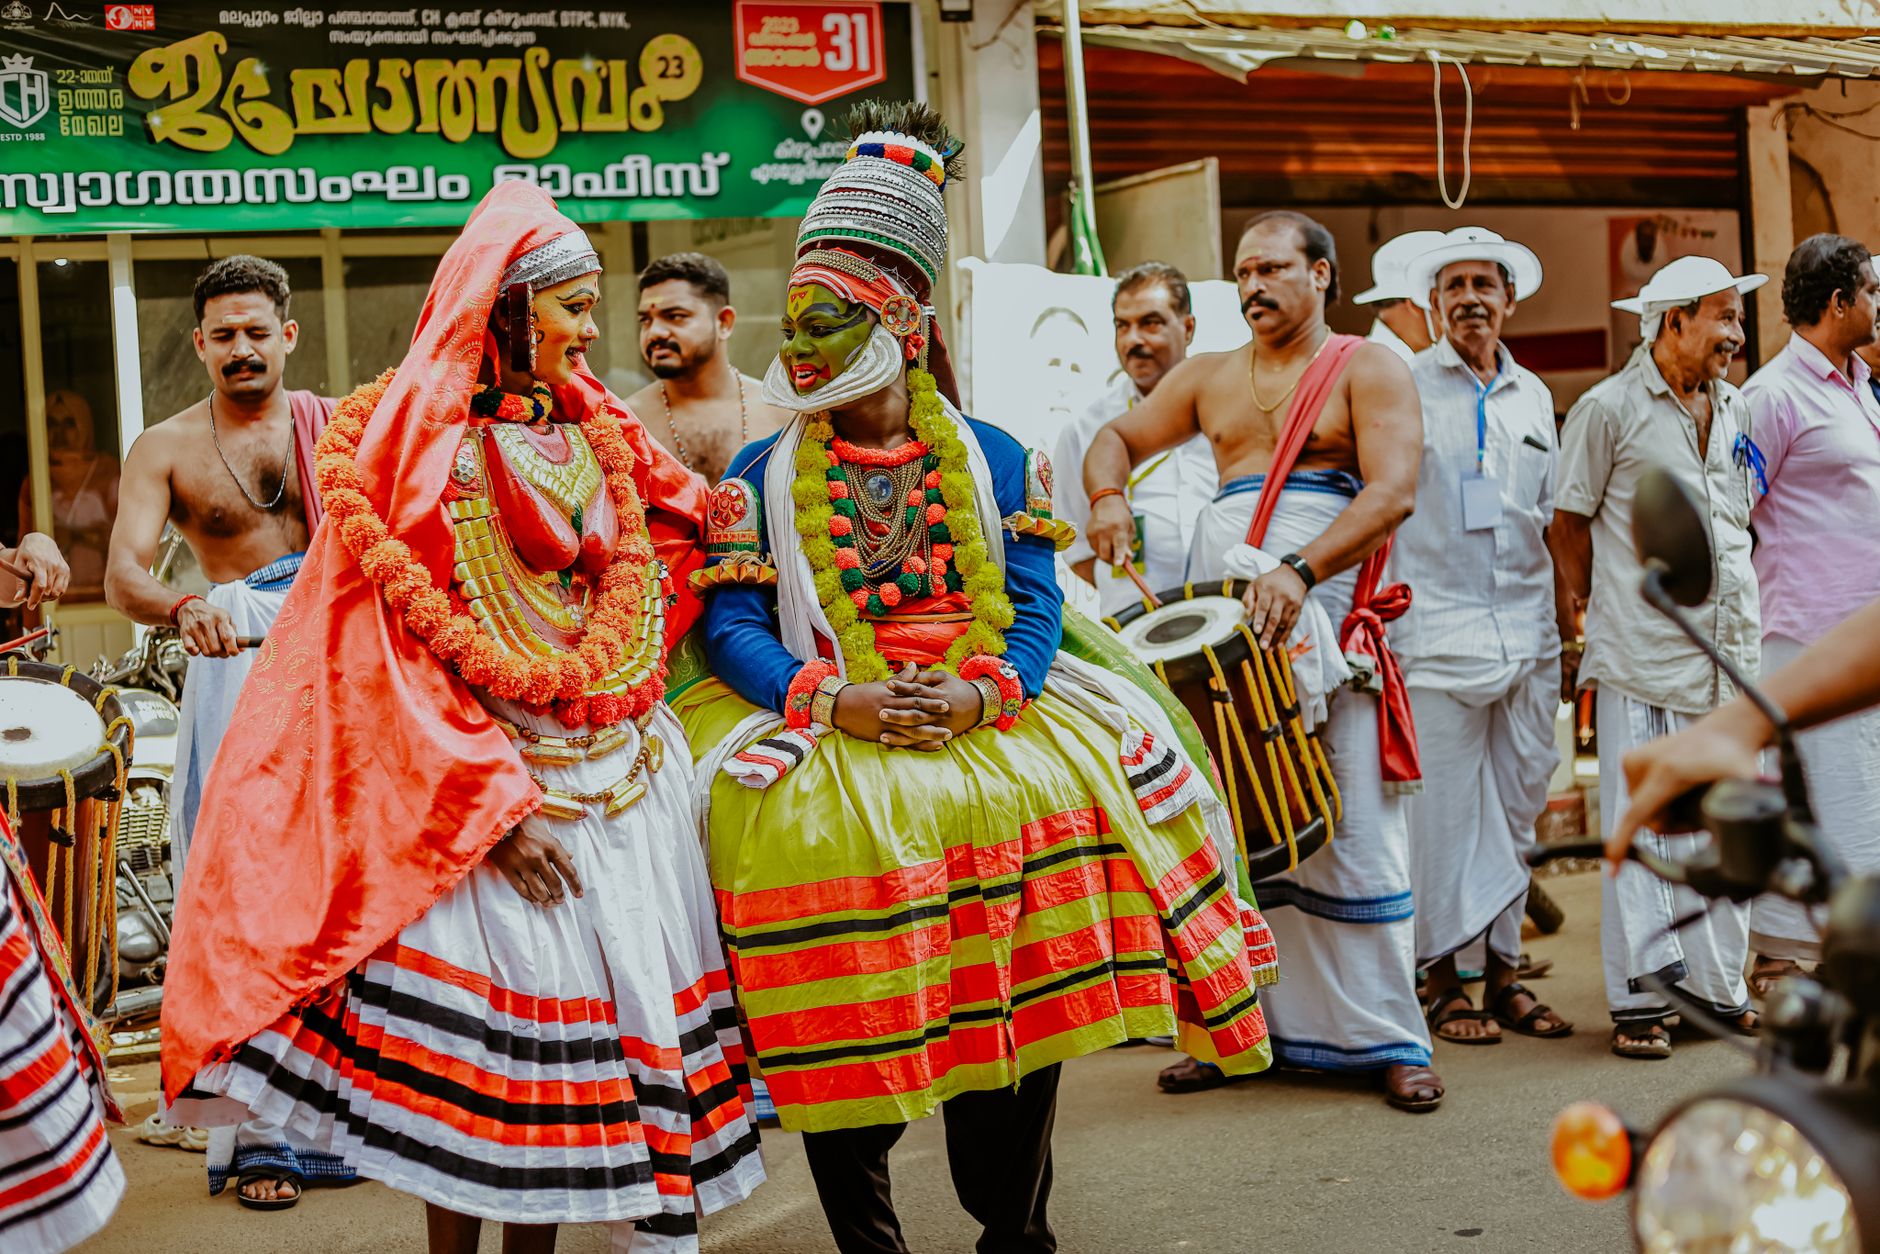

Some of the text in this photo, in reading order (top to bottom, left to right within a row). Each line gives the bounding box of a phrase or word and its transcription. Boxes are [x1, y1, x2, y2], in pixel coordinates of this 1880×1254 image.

[421, 9, 441, 25] CH
[822, 12, 871, 72] 31
[657, 55, 685, 79] 23
[0, 133, 46, 142] ESTD 1988
